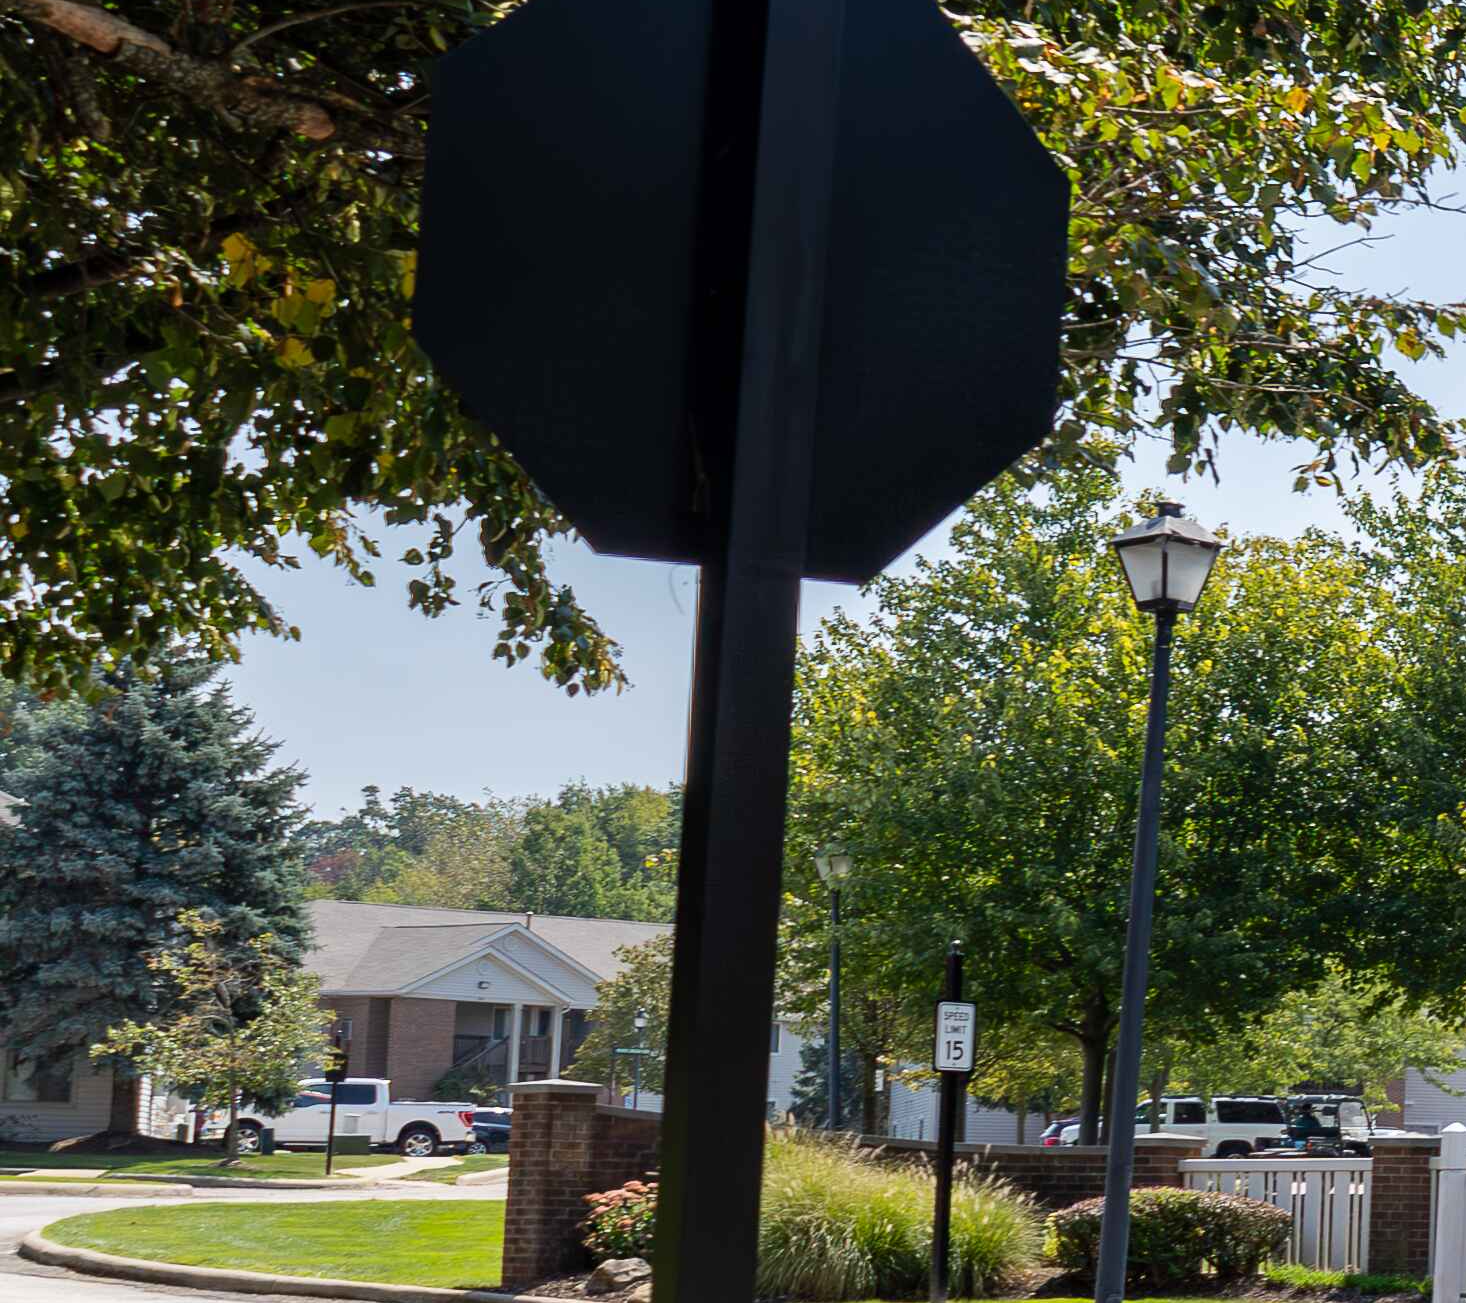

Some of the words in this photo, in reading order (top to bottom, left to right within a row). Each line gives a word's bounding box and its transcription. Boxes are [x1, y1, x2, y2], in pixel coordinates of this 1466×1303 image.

[943, 1011, 969, 1021] SPEED
[944, 1024, 968, 1034] LIMIT
[945, 1040, 964, 1060] 15
